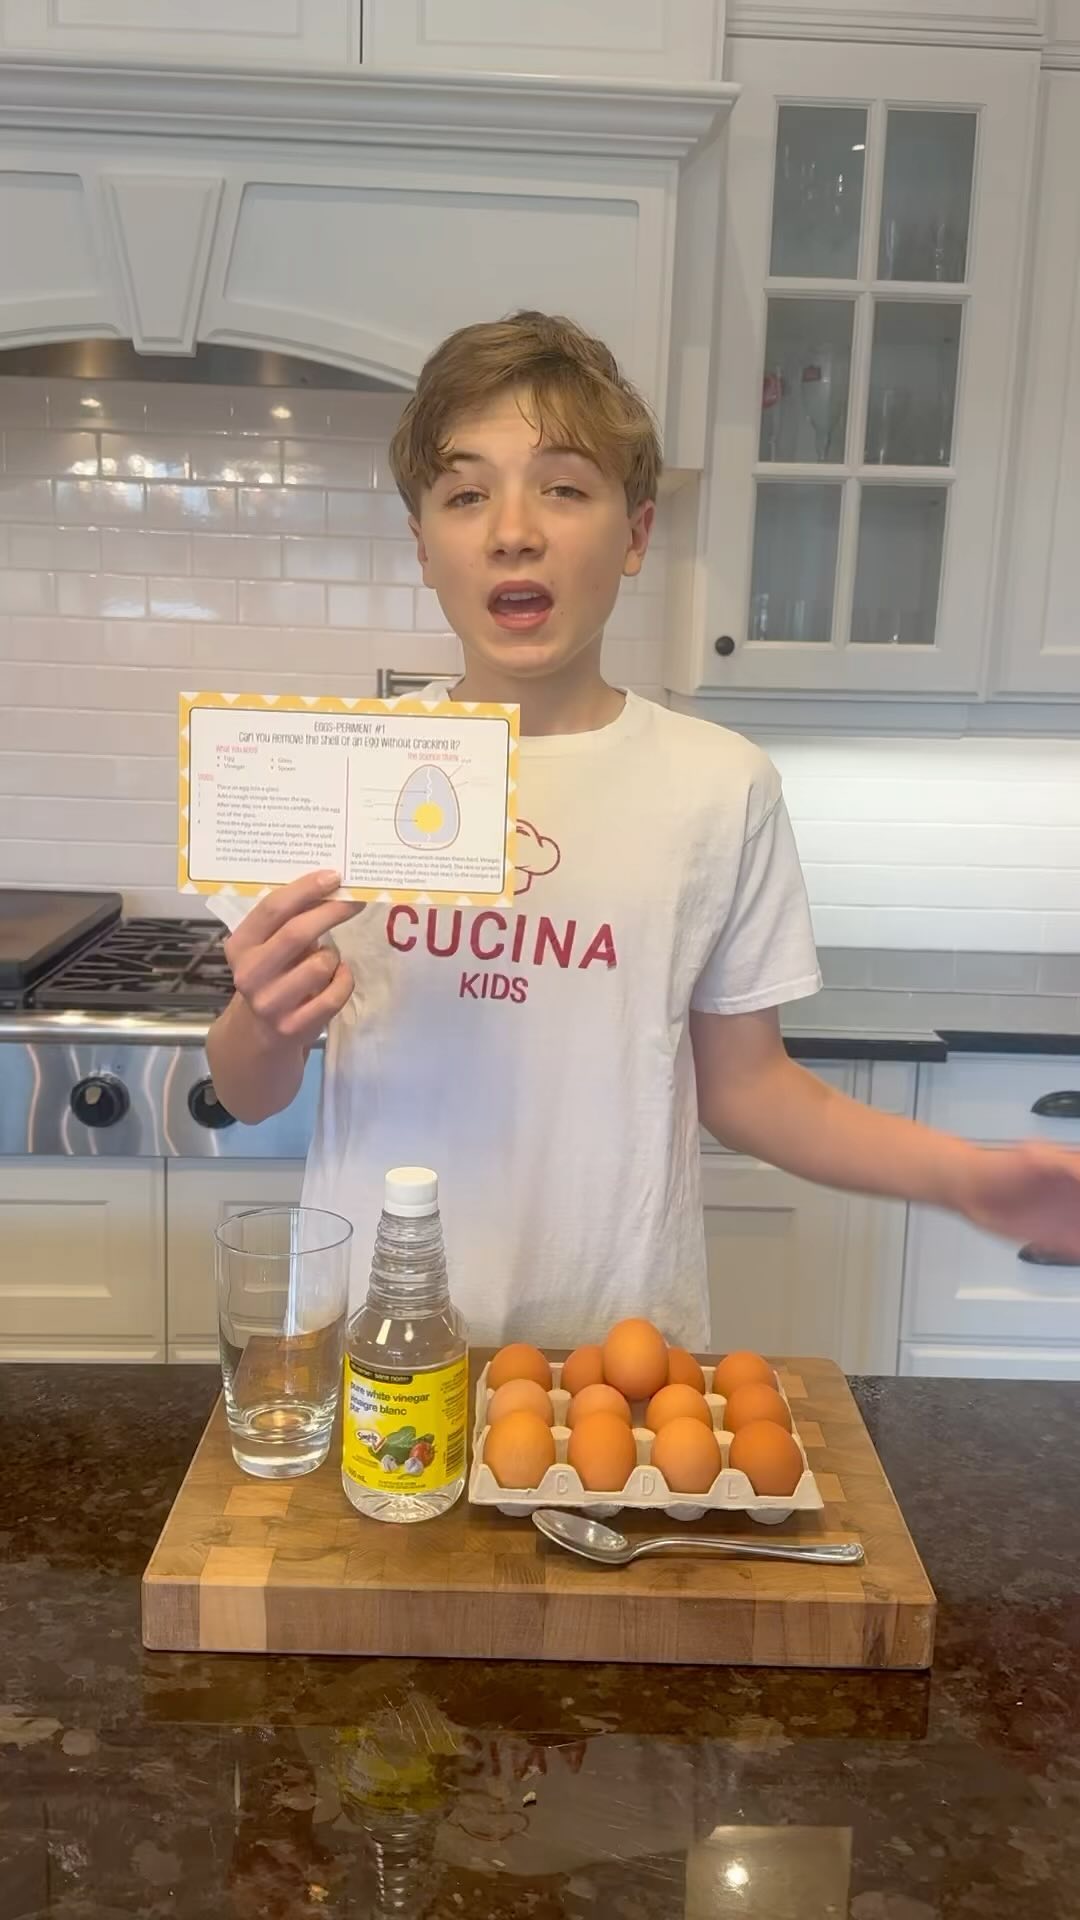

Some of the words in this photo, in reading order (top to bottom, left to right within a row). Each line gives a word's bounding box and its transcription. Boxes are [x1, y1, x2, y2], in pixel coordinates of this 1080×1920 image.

[375, 724, 385, 734] #1
[239, 731, 254, 742] Can
[255, 732, 270, 743] You
[352, 737, 363, 747] an
[364, 736, 379, 748] Egg
[386, 904, 617, 970] CUCINA
[459, 971, 528, 1004] KIDS
[366, 1390, 391, 1402] white
[392, 1393, 430, 1404] vinegar
[379, 1404, 407, 1416] blanc
